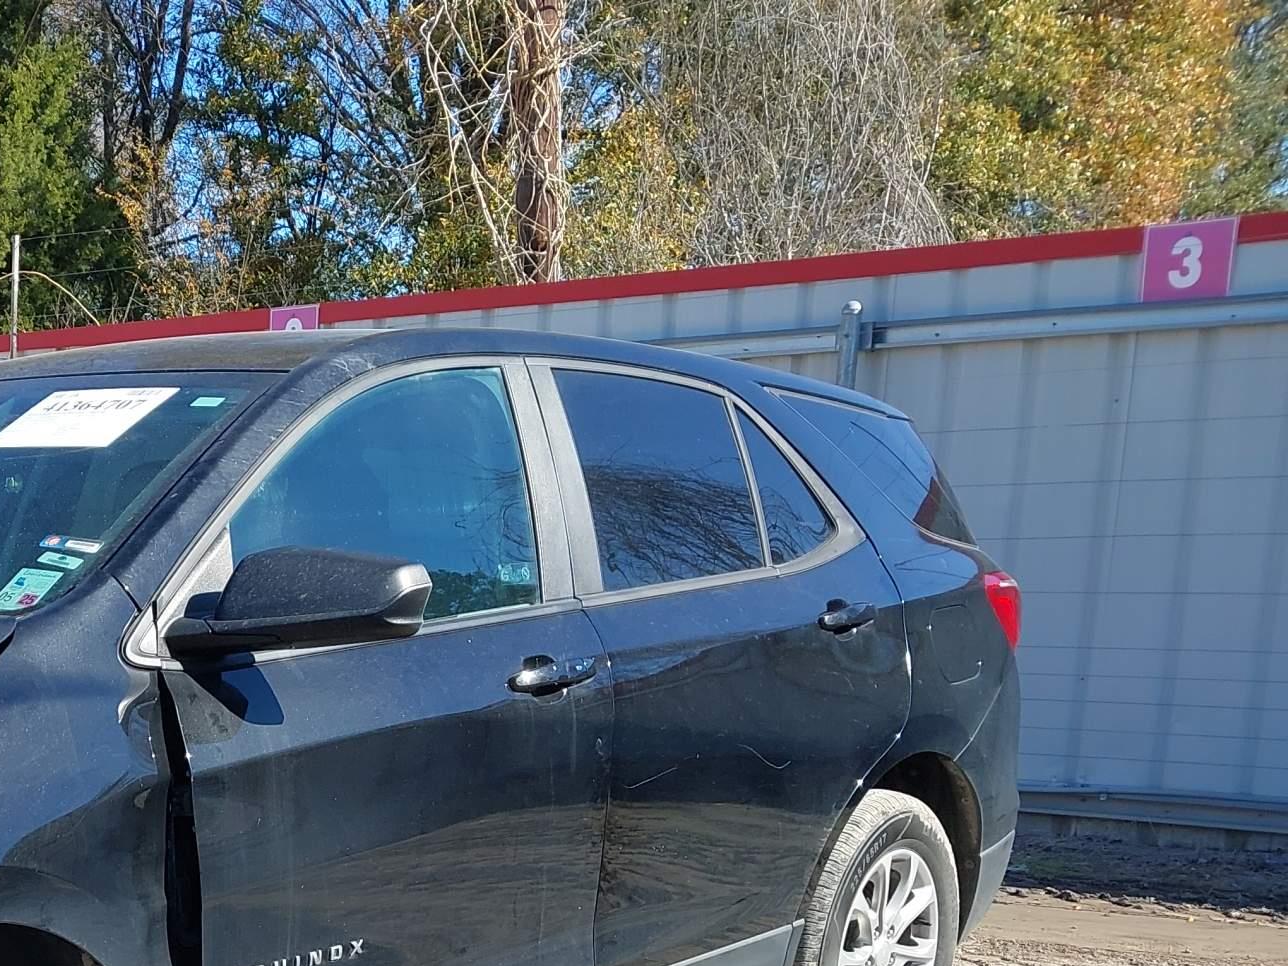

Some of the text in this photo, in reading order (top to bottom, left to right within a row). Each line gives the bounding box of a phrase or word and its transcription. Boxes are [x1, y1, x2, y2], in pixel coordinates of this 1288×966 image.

[1168, 235, 1204, 289] 3
[42, 398, 148, 413] 41364707
[19, 594, 38, 606] 25
